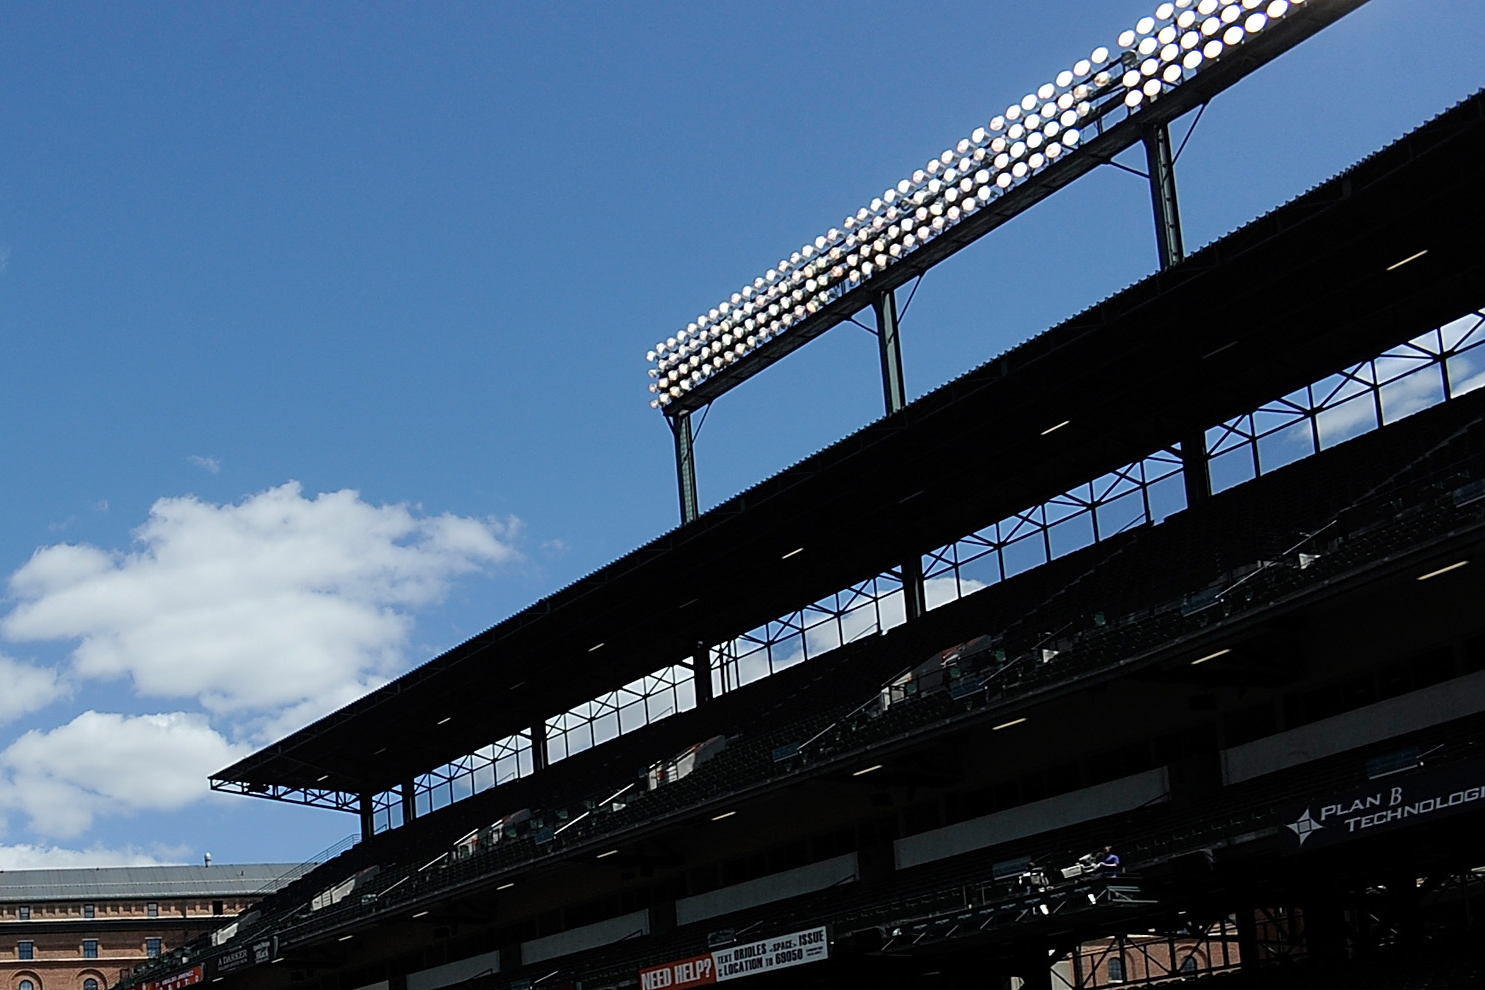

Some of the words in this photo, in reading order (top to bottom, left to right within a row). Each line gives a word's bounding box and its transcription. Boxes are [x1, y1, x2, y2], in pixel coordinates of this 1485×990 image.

[1319, 793, 1382, 821] PLAN
[1388, 787, 1403, 806] B
[717, 954, 732, 963] TEXT
[733, 943, 767, 961] ORIOLES
[799, 930, 824, 947] ISSUE
[724, 957, 764, 974] LOCATION
[775, 948, 804, 965] 69050
[674, 958, 713, 985] HELP?
